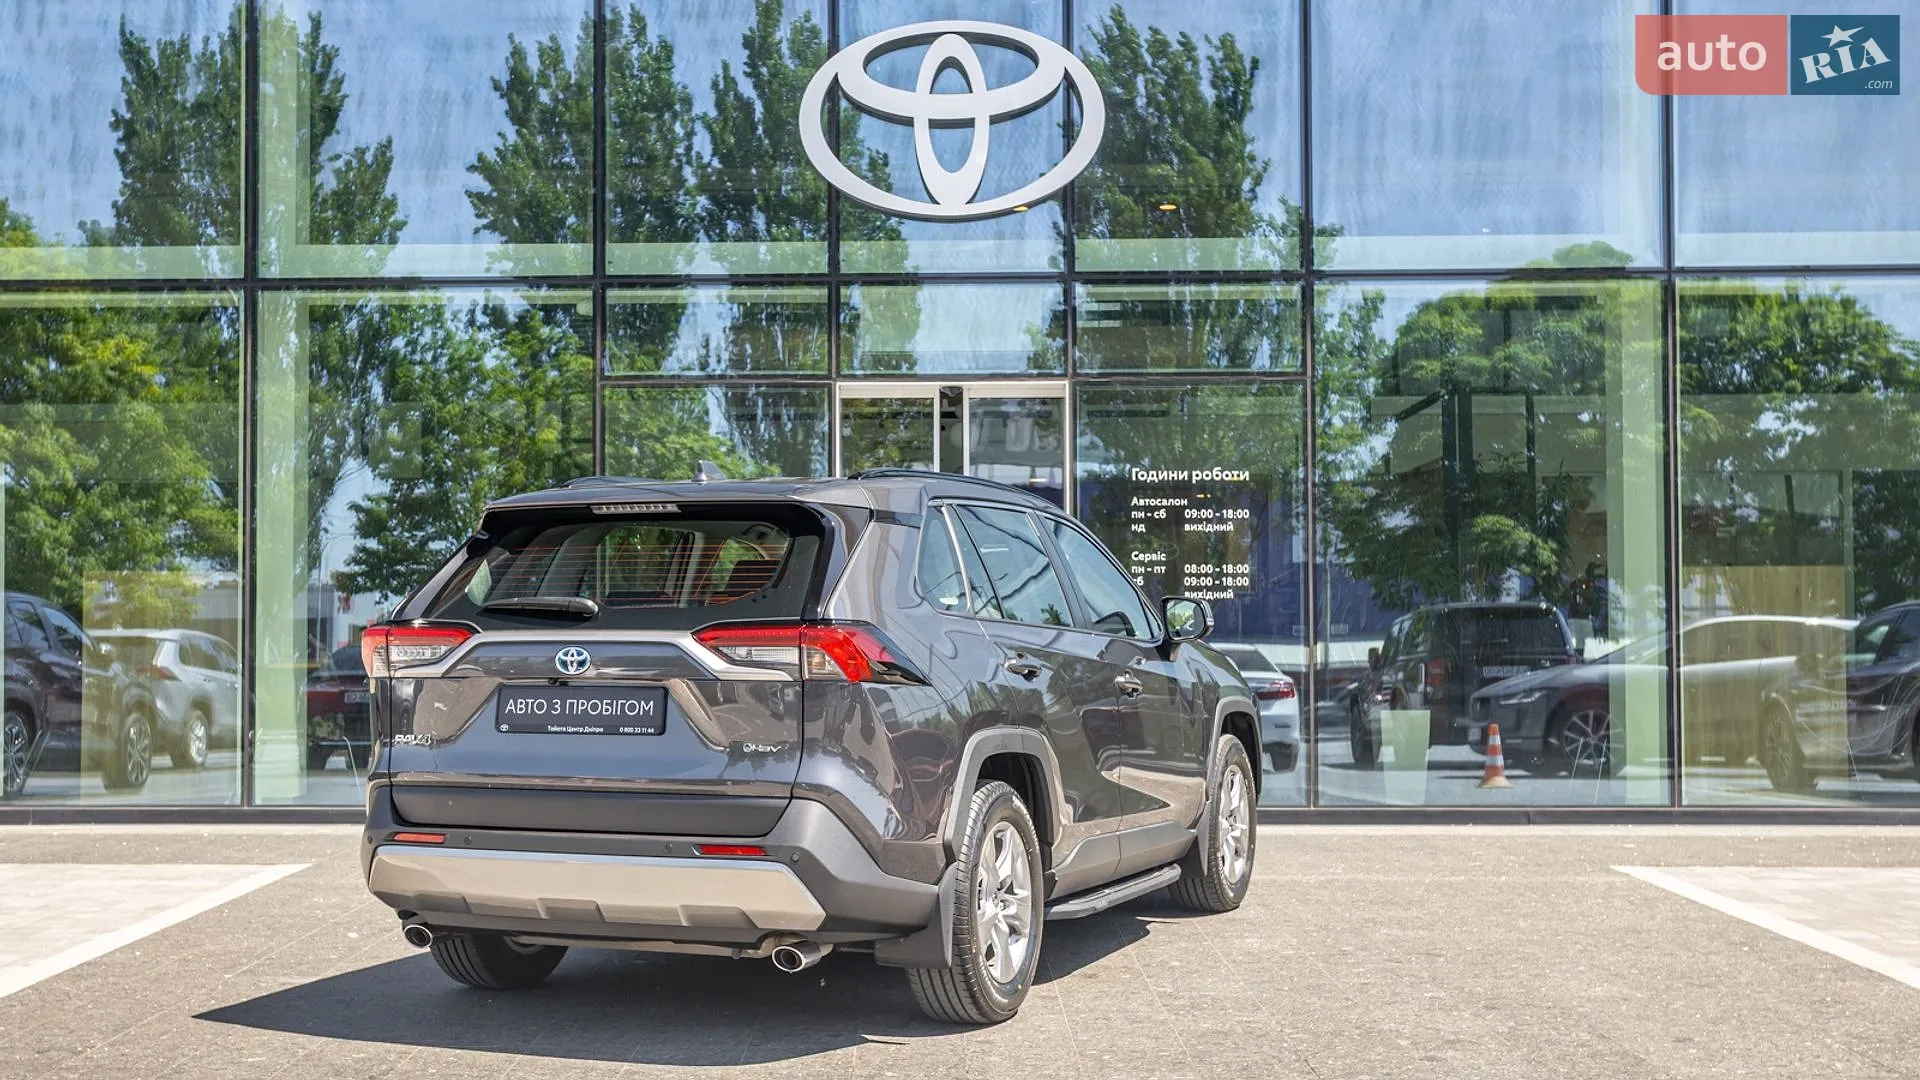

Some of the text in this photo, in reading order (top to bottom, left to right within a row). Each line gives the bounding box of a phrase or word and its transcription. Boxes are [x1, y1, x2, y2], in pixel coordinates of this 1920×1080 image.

[1131, 467, 1250, 484] Години роботи
[1131, 496, 1188, 507] Автосалон
[1131, 510, 1145, 519] пн
[1153, 508, 1167, 519] сб
[1184, 508, 1213, 519] 09:00
[1222, 508, 1250, 519] 18:00
[1131, 522, 1146, 533] нд
[1184, 521, 1234, 533] вихідний
[1131, 551, 1167, 563] Сервіс
[1131, 566, 1145, 574] пн
[1153, 566, 1166, 574] пт
[1184, 563, 1213, 574] 08:00
[1222, 563, 1250, 574] 18:00
[1184, 576, 1213, 587] 09:00
[1222, 576, 1250, 587] 18:00
[1184, 589, 1234, 600] вихідний
[505, 699, 654, 716] АВТО З ПРОБІГОМ
